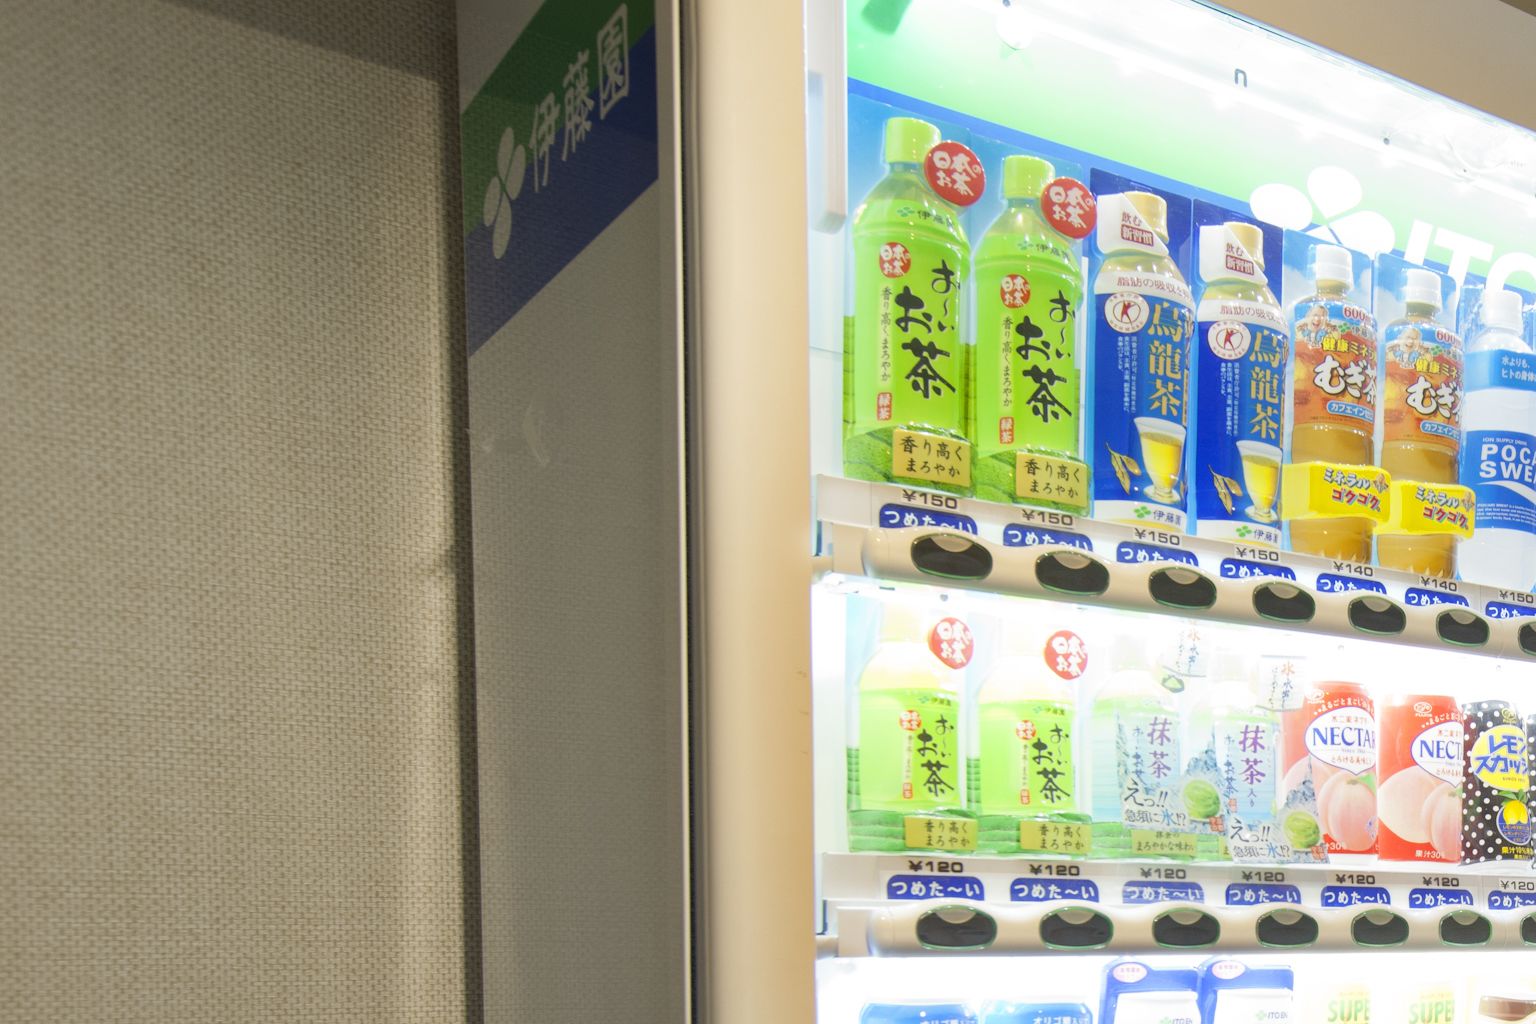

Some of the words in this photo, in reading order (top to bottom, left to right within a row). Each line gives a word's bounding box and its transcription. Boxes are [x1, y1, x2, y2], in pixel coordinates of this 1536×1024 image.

[528, 3, 630, 193] 伊藤園
[1121, 212, 1142, 226] 飲む
[1226, 243, 1244, 257] 飲む
[894, 285, 956, 399] お茶
[1015, 315, 1073, 423] お茶
[900, 436, 963, 461] 香り高く
[905, 458, 961, 478] まろやか
[1024, 458, 1081, 483] 香り高く
[1323, 468, 1371, 490] ミネラル
[1028, 480, 1080, 499] まろやか
[902, 490, 959, 509] ¥150
[1415, 486, 1459, 509] ミネラル
[1022, 509, 1075, 526] ¥150
[1134, 528, 1180, 546] ¥150
[1235, 546, 1279, 561] ¥150
[1333, 561, 1374, 576] ¥140
[1420, 576, 1458, 592] ¥140
[1499, 589, 1534, 604] ¥150
[1147, 716, 1172, 779] 抹茶
[916, 730, 954, 797] お茶
[1031, 738, 1071, 803] お茶
[923, 820, 968, 834] 香り高く
[1039, 825, 1082, 838] 香り高く
[925, 835, 970, 847] まろやか
[1039, 838, 1084, 851] まろやか
[908, 859, 963, 874] ¥120
[1029, 864, 1080, 877] ¥120
[1140, 867, 1187, 881] ¥120
[1241, 870, 1285, 883] ¥120
[1335, 873, 1376, 885] ¥120
[1422, 876, 1460, 887] ¥120
[1501, 879, 1535, 891] ¥120
